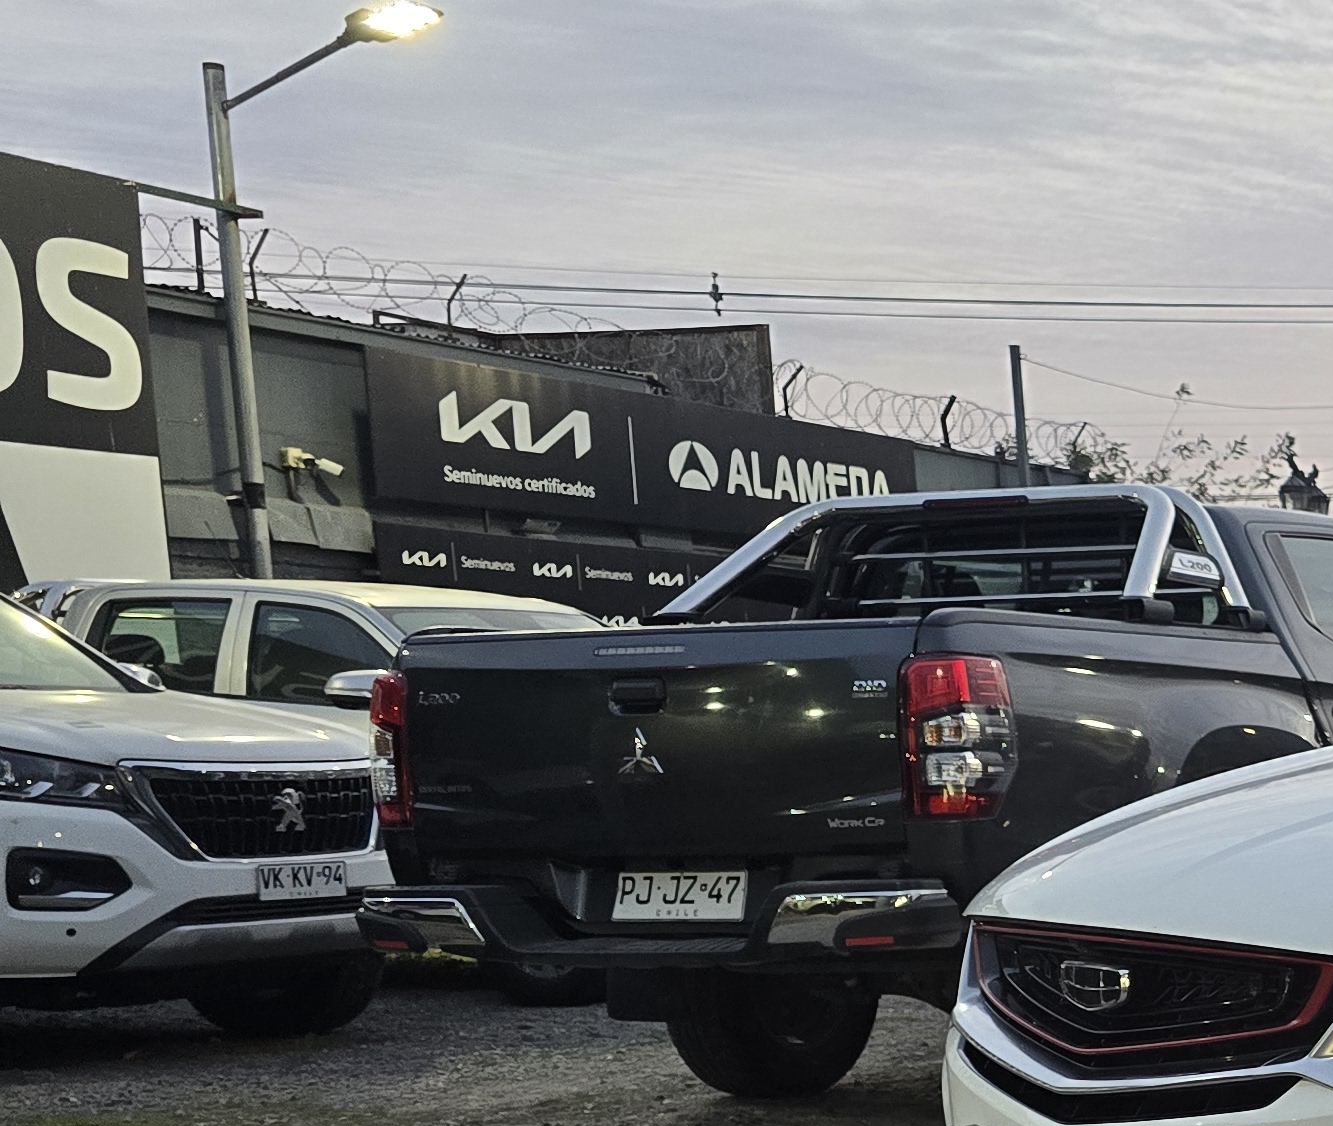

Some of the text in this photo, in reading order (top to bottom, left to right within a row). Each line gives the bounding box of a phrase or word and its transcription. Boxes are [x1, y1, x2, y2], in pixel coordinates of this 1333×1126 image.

[0, 237, 142, 411] S
[438, 390, 592, 460] KIA
[443, 464, 596, 499] Seminuevos certificados
[727, 448, 890, 504] ALAMEDA
[401, 549, 447, 568] KIA
[532, 562, 573, 578] KIA
[648, 571, 685, 587] KIA
[1178, 557, 1213, 573] L200
